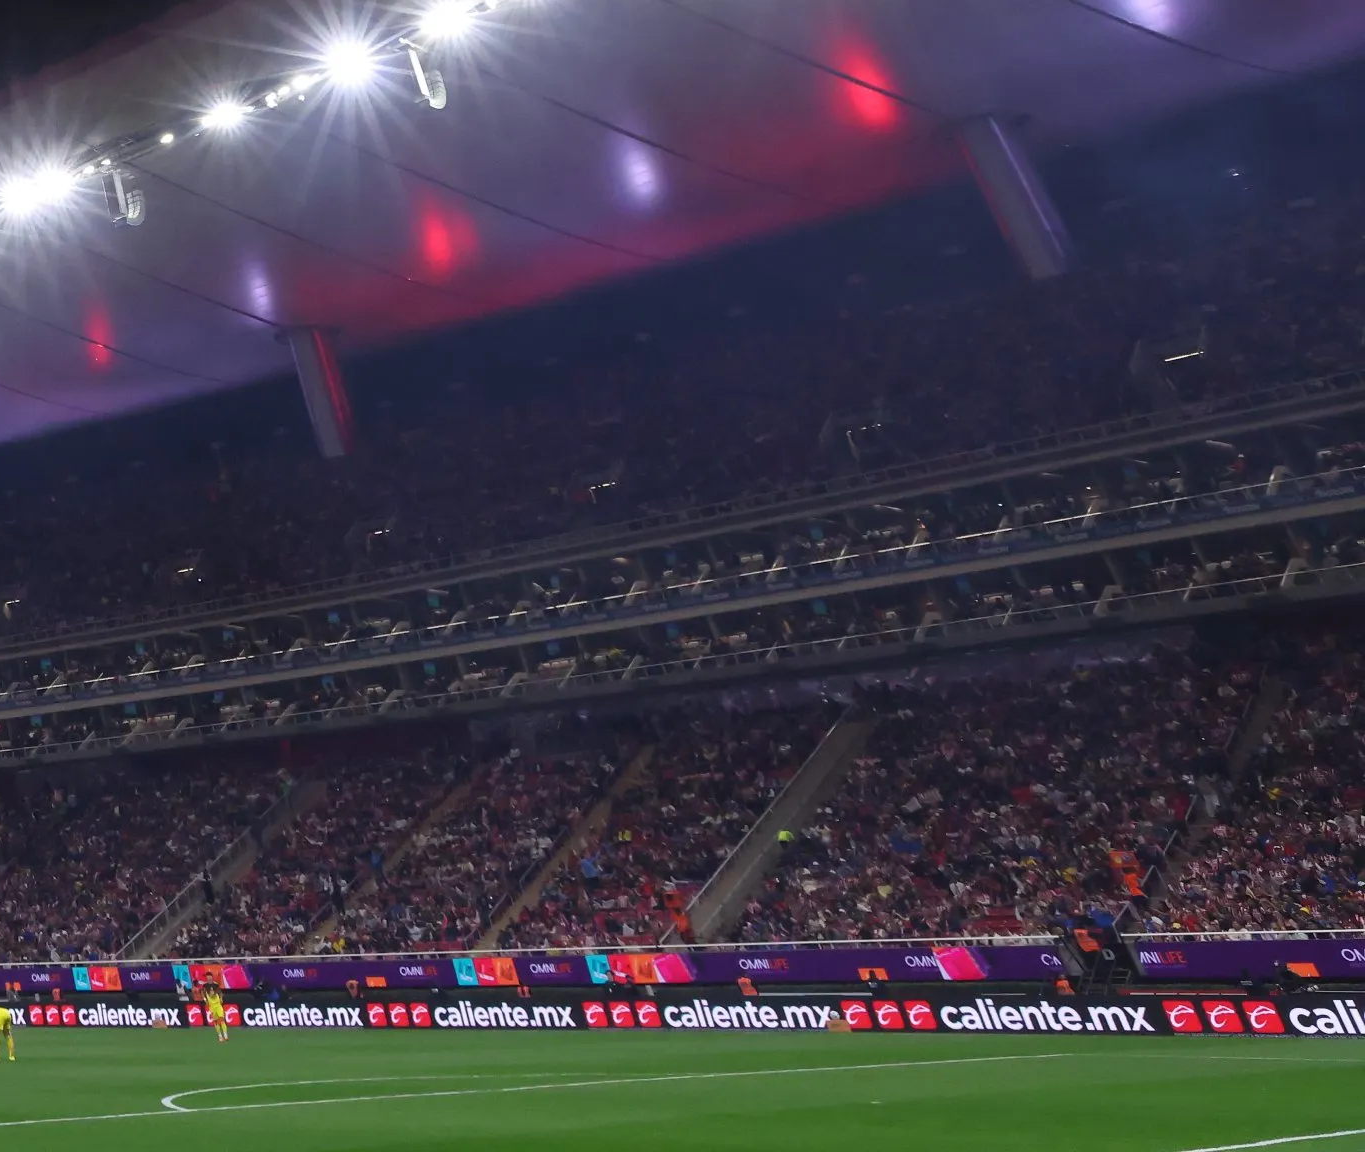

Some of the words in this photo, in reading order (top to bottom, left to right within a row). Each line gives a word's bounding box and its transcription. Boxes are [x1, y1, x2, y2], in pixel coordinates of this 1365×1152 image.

[739, 958, 790, 970] OMNILIFE
[79, 1003, 182, 1026] caliente.mx
[243, 1002, 364, 1027] caliente.mx
[434, 1001, 577, 1028] caliente.mx
[664, 999, 831, 1028] caliente.mx
[940, 999, 1155, 1032] caliente.mx
